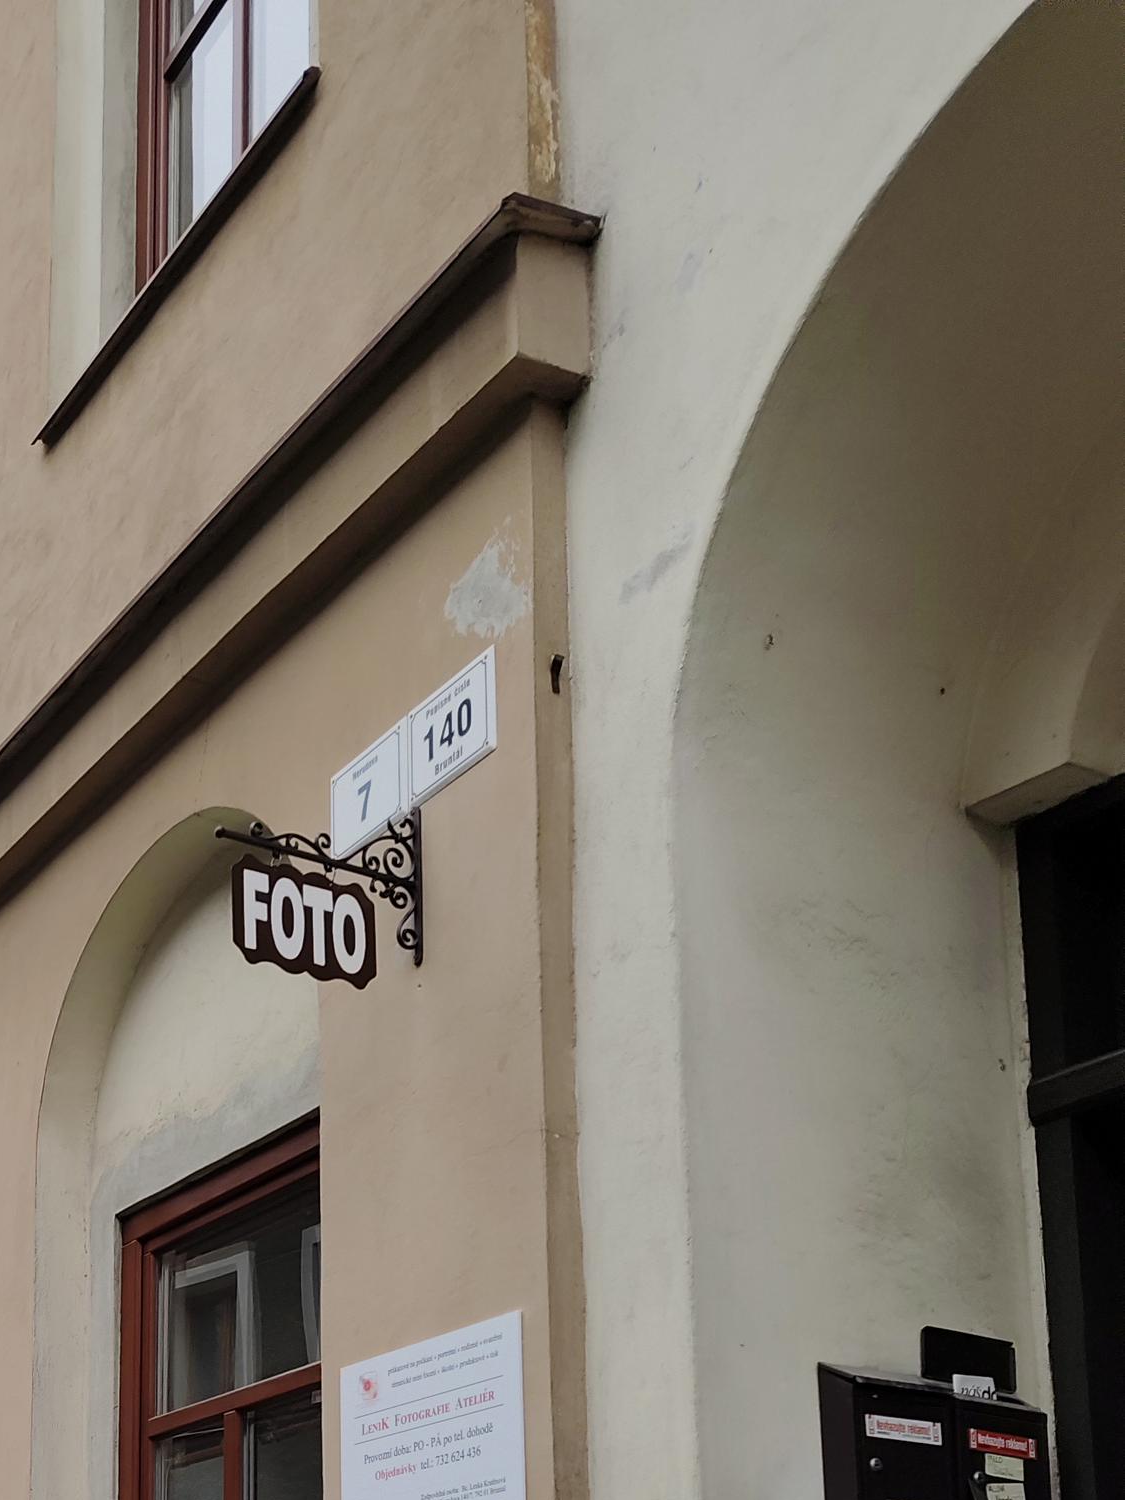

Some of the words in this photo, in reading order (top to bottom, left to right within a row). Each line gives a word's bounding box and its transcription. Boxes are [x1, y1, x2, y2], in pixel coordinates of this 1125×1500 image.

[424, 698, 472, 762] 140
[358, 780, 372, 822] 7
[243, 868, 366, 974] FOTO
[395, 1401, 450, 1426] FOTOGRAFIE
[456, 1387, 494, 1409] ATELIÉR
[364, 1450, 391, 1464] Provozní
[394, 1445, 411, 1457] doba:
[413, 1441, 424, 1452] PO
[430, 1434, 441, 1446] PÁ
[443, 1437, 452, 1447] po
[453, 1432, 464, 1442] tel.
[467, 1424, 493, 1438] dohodě
[436, 1455, 448, 1466] 732
[451, 1451, 464, 1462] 624
[467, 1447, 481, 1458] 436
